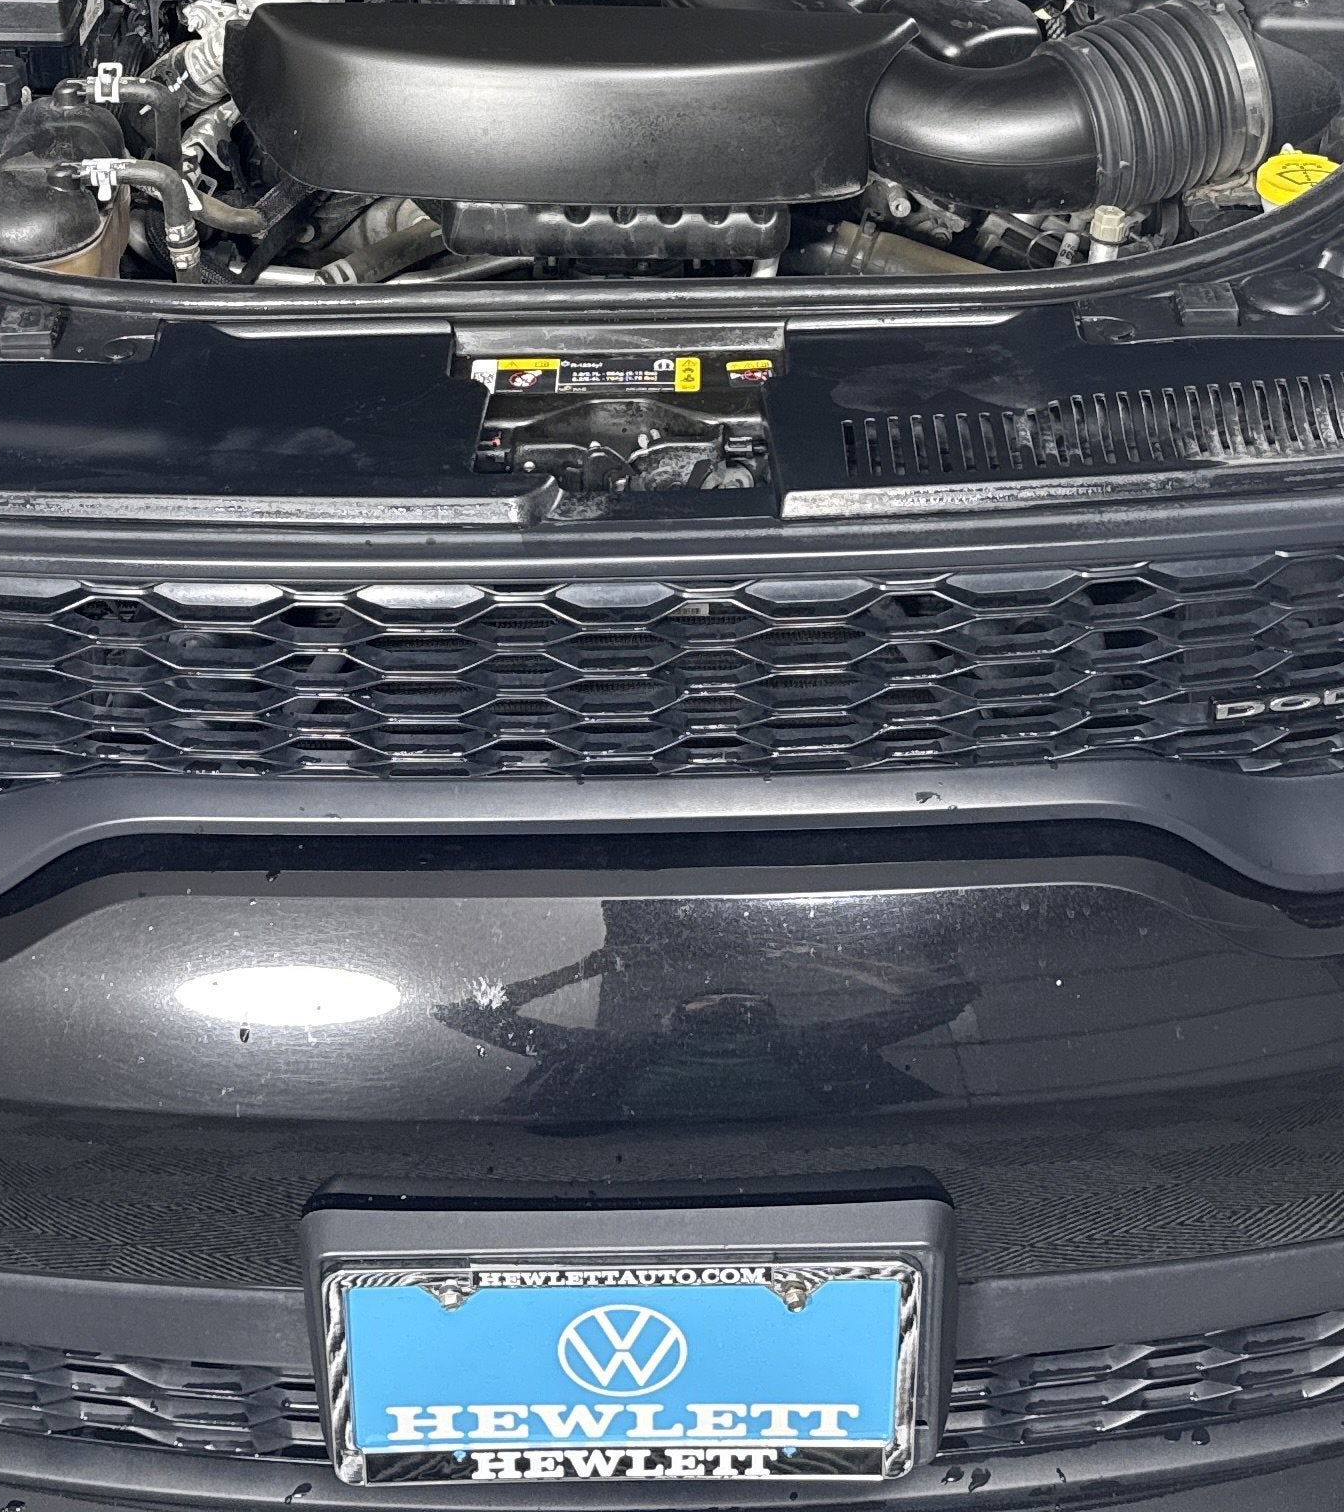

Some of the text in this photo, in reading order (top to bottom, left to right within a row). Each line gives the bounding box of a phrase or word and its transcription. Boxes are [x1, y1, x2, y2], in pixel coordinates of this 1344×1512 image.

[478, 1268, 766, 1287] HEWLETTAUTO.COM
[385, 1403, 860, 1441] HEWLETT
[471, 1448, 778, 1479] HEWLETT
